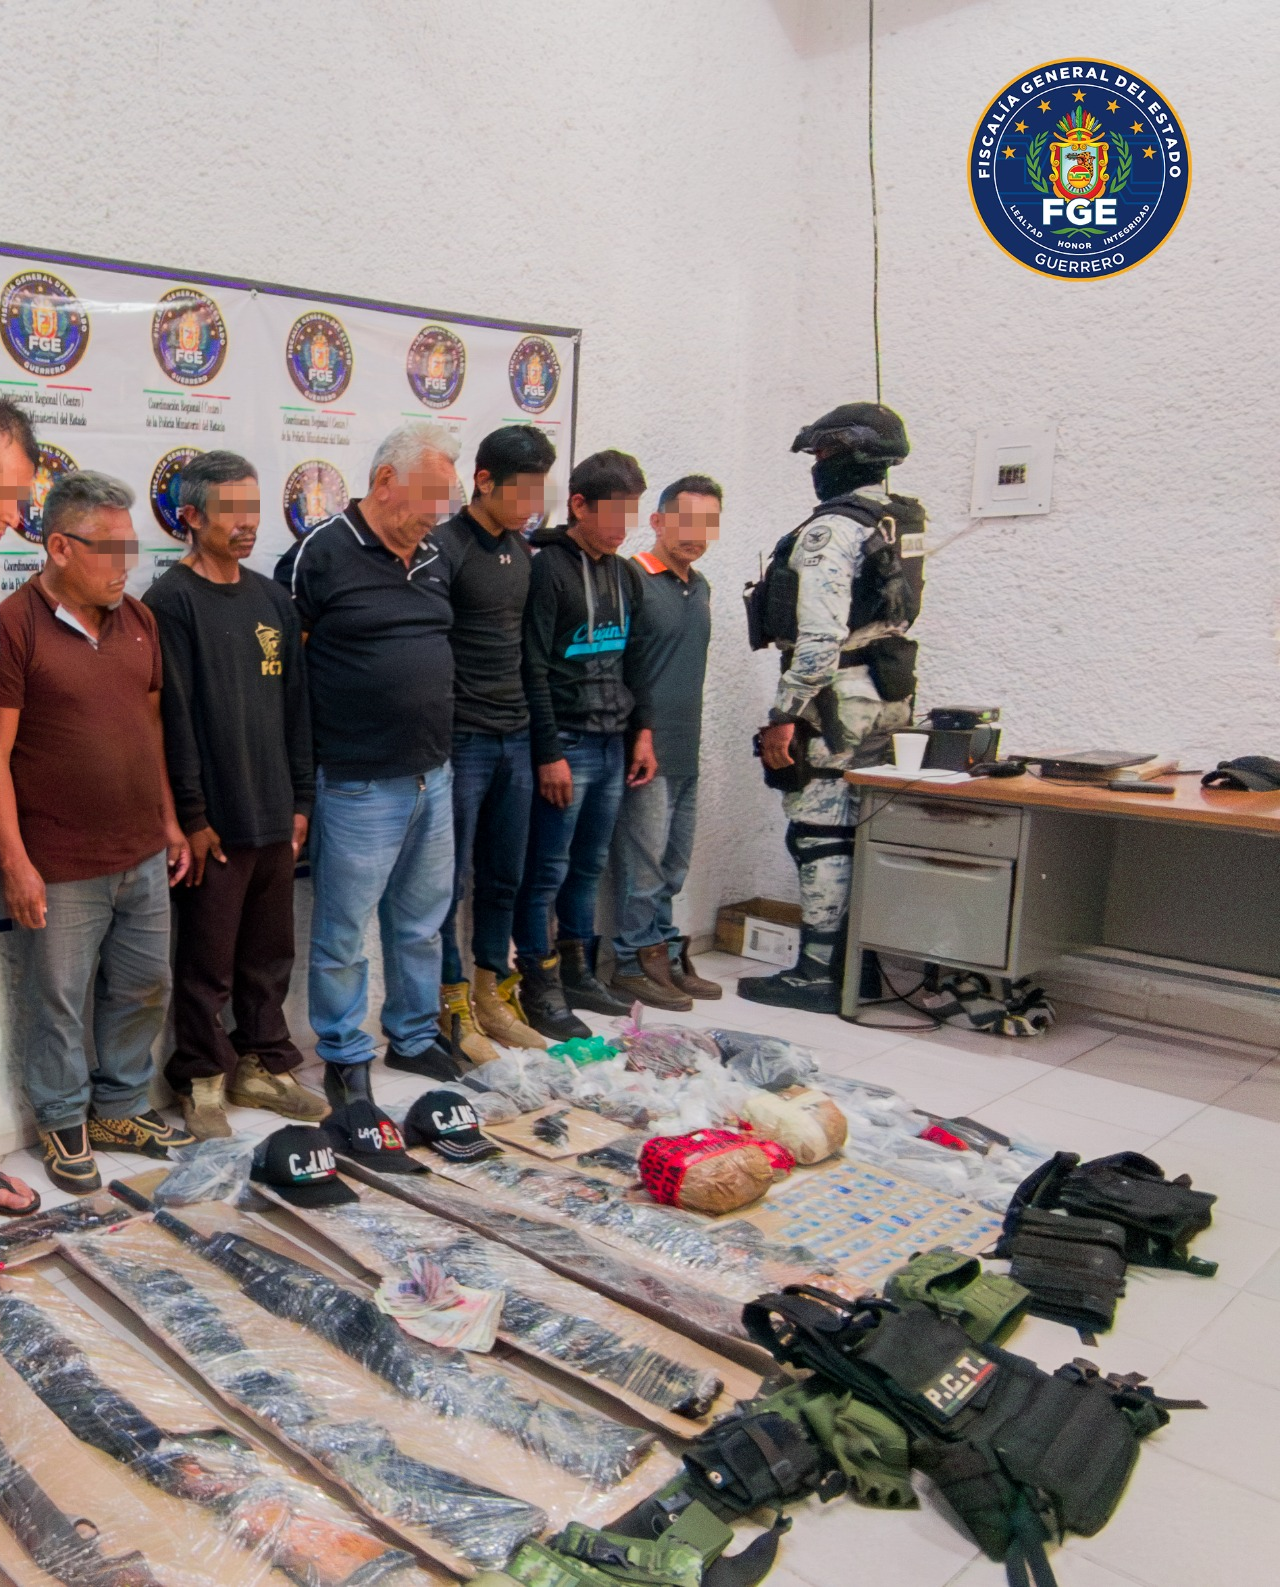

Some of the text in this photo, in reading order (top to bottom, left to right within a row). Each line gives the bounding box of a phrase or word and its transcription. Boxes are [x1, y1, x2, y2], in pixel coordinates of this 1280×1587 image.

[28, 336, 62, 353] FGE
[175, 349, 203, 364] FGE
[308, 368, 333, 382] FGE
[425, 377, 447, 390] FGE
[524, 384, 546, 396] FGE
[924, 1356, 989, 1409] P.C.T.
